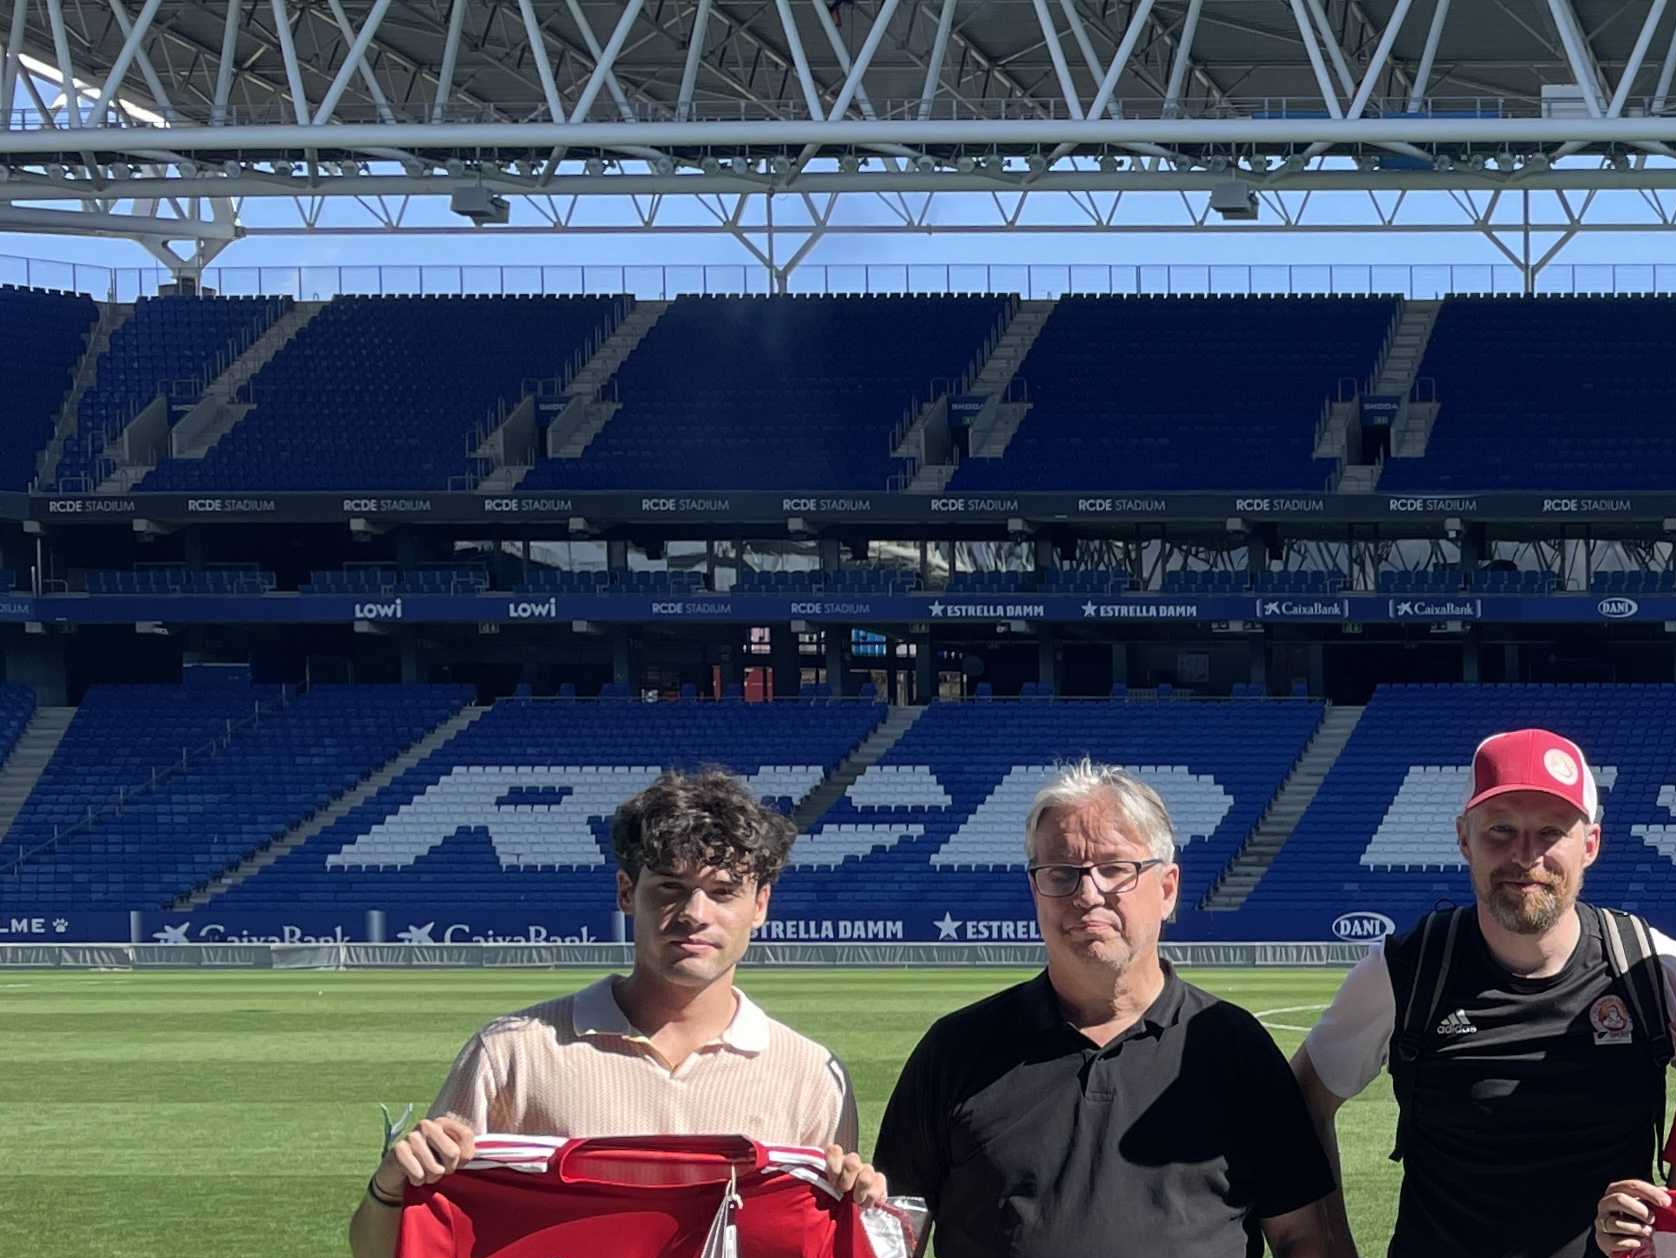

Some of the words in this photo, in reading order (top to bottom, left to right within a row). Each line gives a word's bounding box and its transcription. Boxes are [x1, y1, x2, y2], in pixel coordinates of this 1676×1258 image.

[49, 500, 83, 513] RCDE
[85, 500, 136, 512] STADIUM
[188, 499, 222, 512] RCDE
[223, 499, 275, 512] STADIUM
[343, 499, 378, 512] RCDE
[380, 499, 432, 512] STADIUM
[484, 498, 519, 512] RCDE
[521, 499, 572, 511] STADIUM
[642, 498, 676, 511] RCDE
[678, 498, 730, 511] STADIUM
[782, 498, 817, 511] RCDE
[819, 499, 871, 511] STADIUM
[931, 498, 965, 511] RCDE
[967, 499, 1019, 512] STADIUM
[1078, 498, 1113, 512] RCDE
[1115, 499, 1166, 512] STADIUM
[1236, 498, 1270, 511] RCDE
[1272, 498, 1324, 512] STADIUM
[1389, 498, 1424, 511] RCDE
[1426, 499, 1477, 511] STADIUM
[1543, 498, 1578, 512] RCDE
[1580, 499, 1631, 512] STADIUM
[652, 602, 683, 614] RCDE
[685, 602, 732, 614] STADIUM
[790, 602, 822, 614] RCDE
[823, 602, 871, 614] STADIUM
[946, 605, 1004, 617] ESTRELLA
[1006, 605, 1044, 617] DAMM
[1099, 605, 1157, 617] ESTRELLA
[1159, 605, 1197, 617] DAMM
[1281, 601, 1341, 615] CaixaBank
[1413, 601, 1474, 616] CaixaBank
[1602, 602, 1630, 614] DANI
[838, 920, 903, 939] DAMM
[966, 920, 1040, 939] ESTREL
[1338, 918, 1381, 936] DANI
